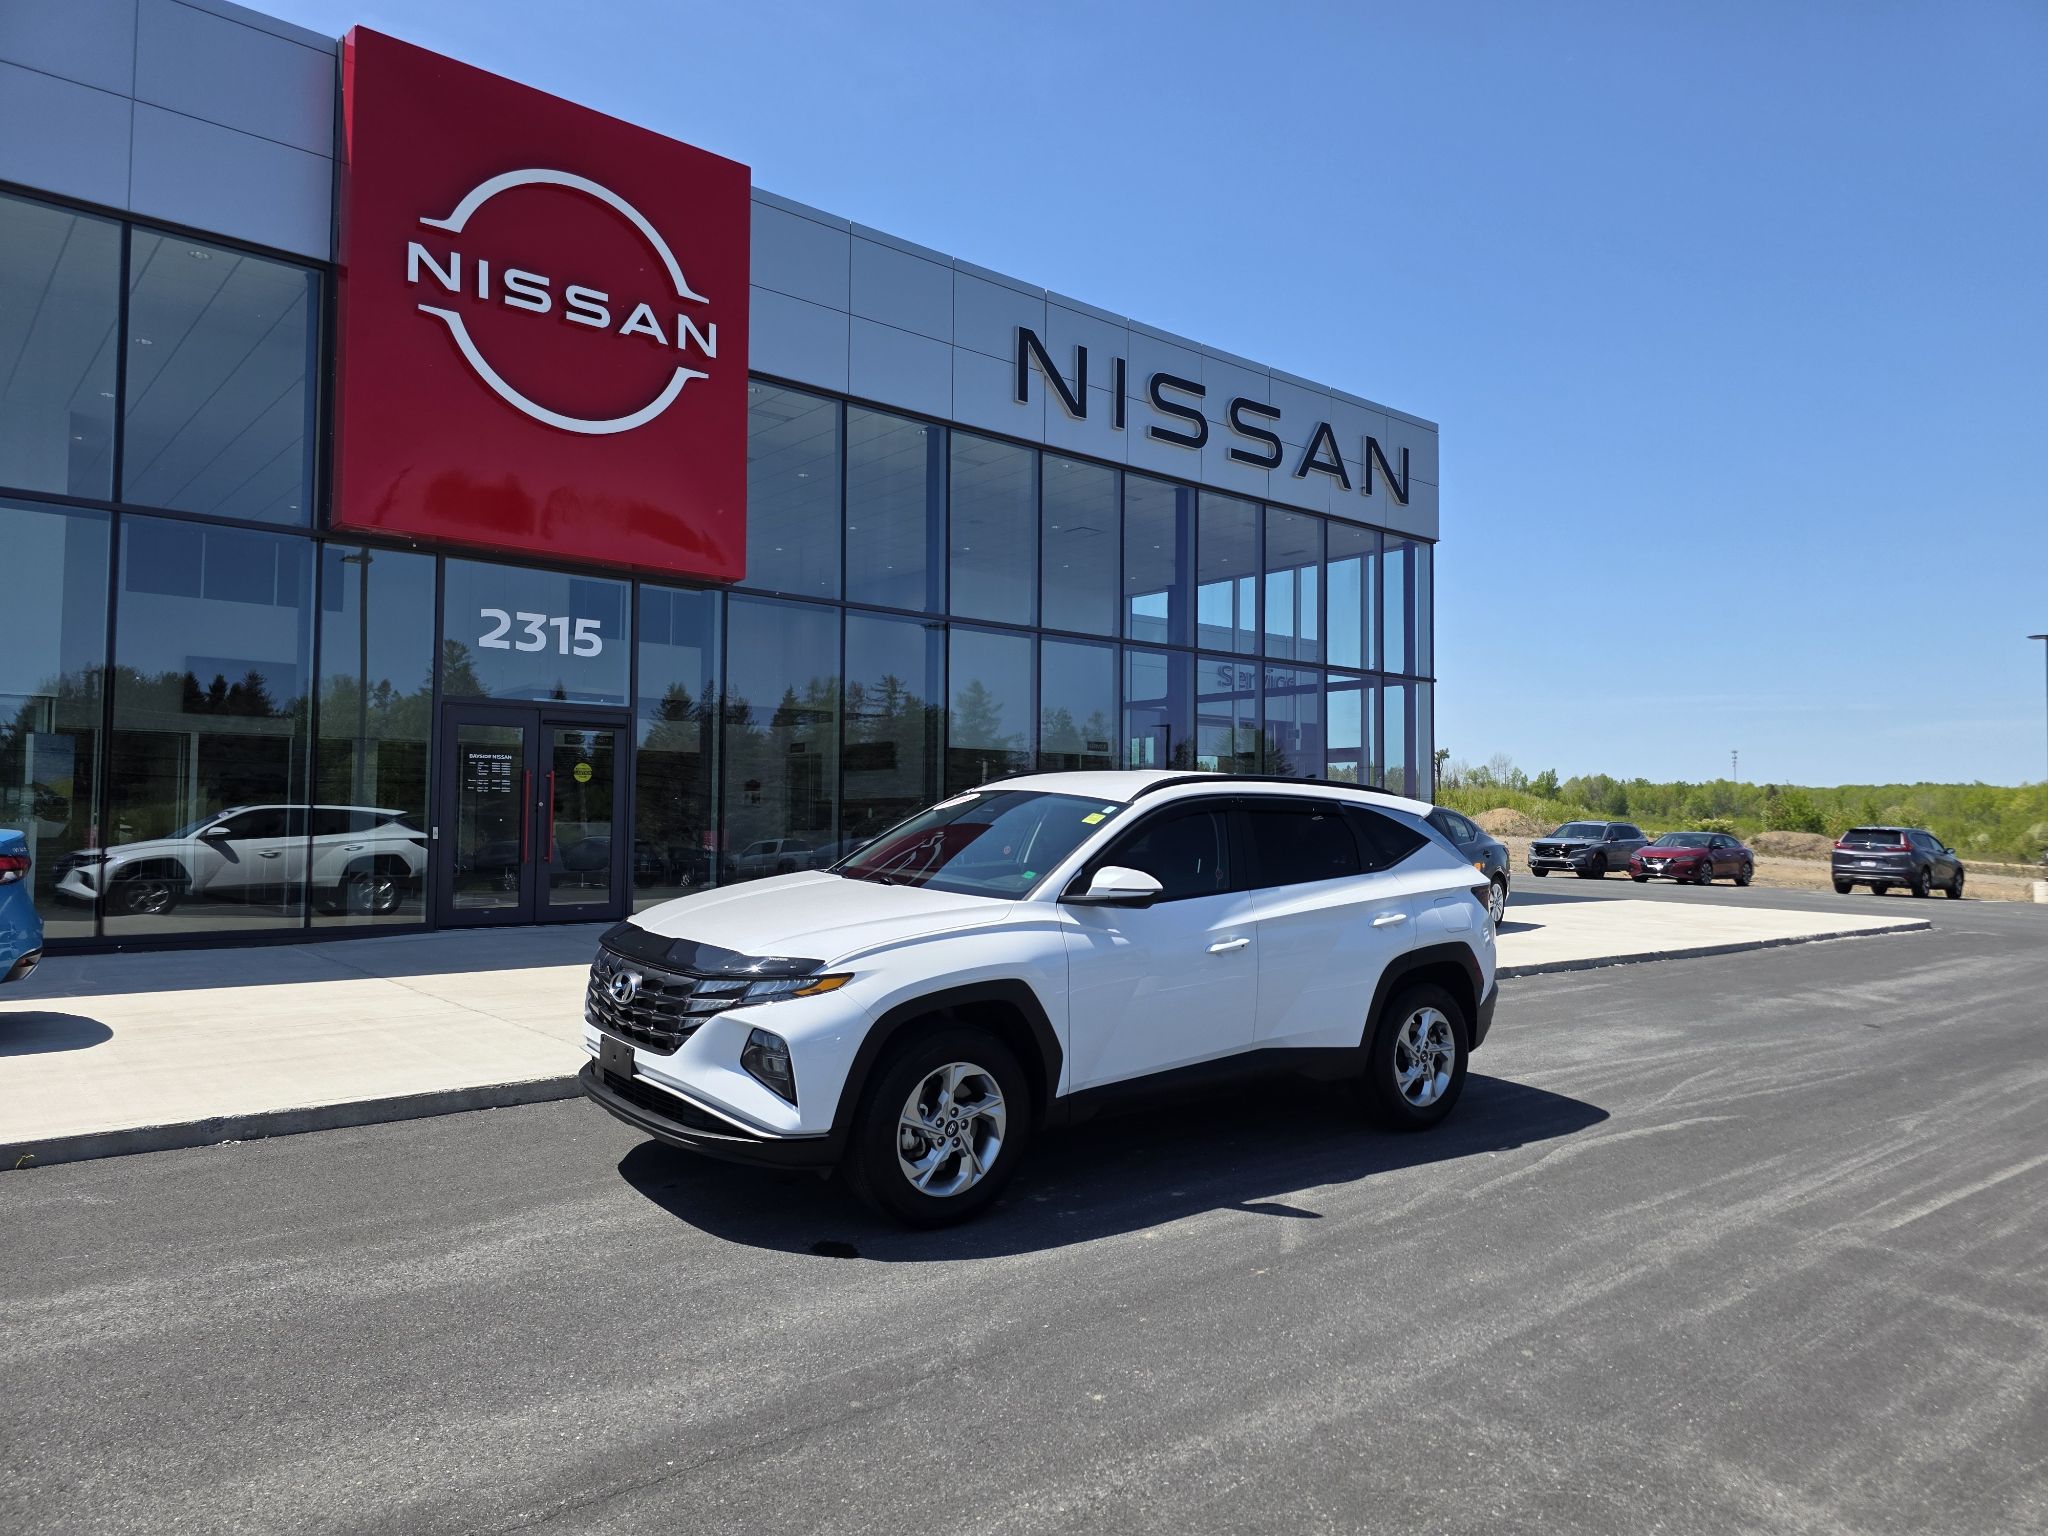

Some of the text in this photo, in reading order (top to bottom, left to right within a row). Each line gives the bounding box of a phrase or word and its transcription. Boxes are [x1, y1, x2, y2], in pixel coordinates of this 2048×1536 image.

[407, 240, 718, 360] NISSAN
[1014, 325, 1411, 506] NISSAN
[478, 607, 603, 658] 2315
